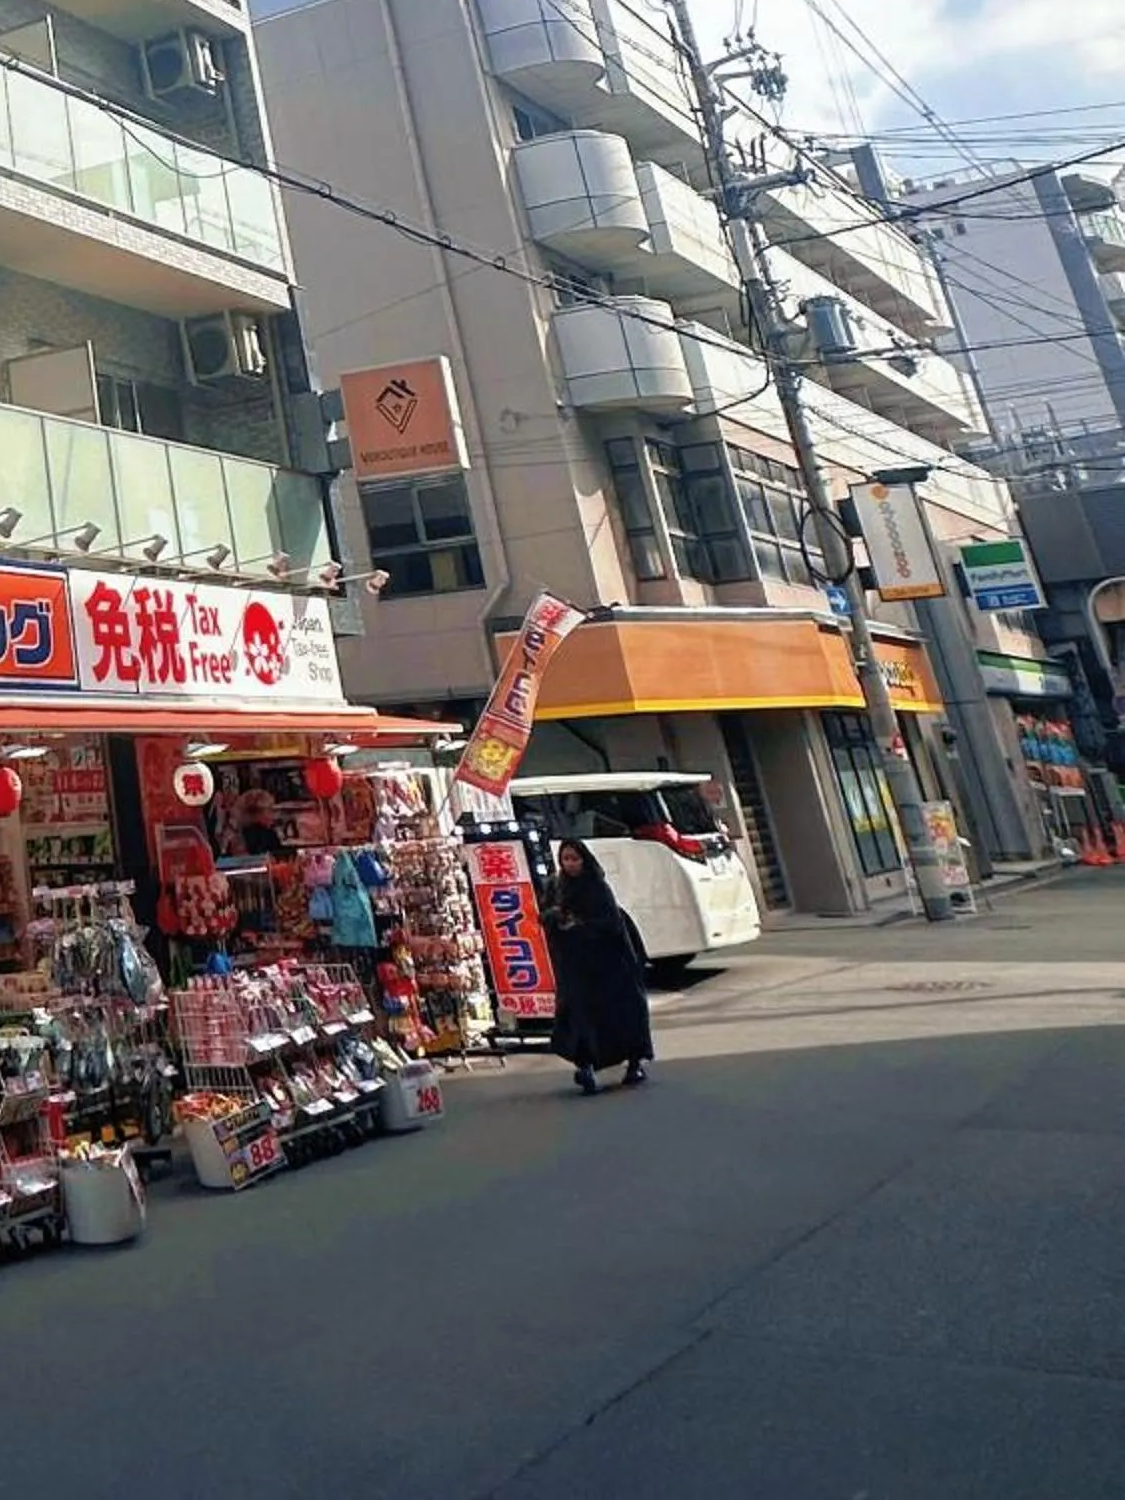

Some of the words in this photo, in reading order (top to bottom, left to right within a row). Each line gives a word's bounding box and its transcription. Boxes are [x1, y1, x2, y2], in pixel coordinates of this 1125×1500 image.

[84, 580, 187, 683] 免税
[185, 591, 222, 637] Tax
[188, 641, 232, 683] Free
[490, 888, 540, 990] ダイコク
[249, 1136, 274, 1165] 88
